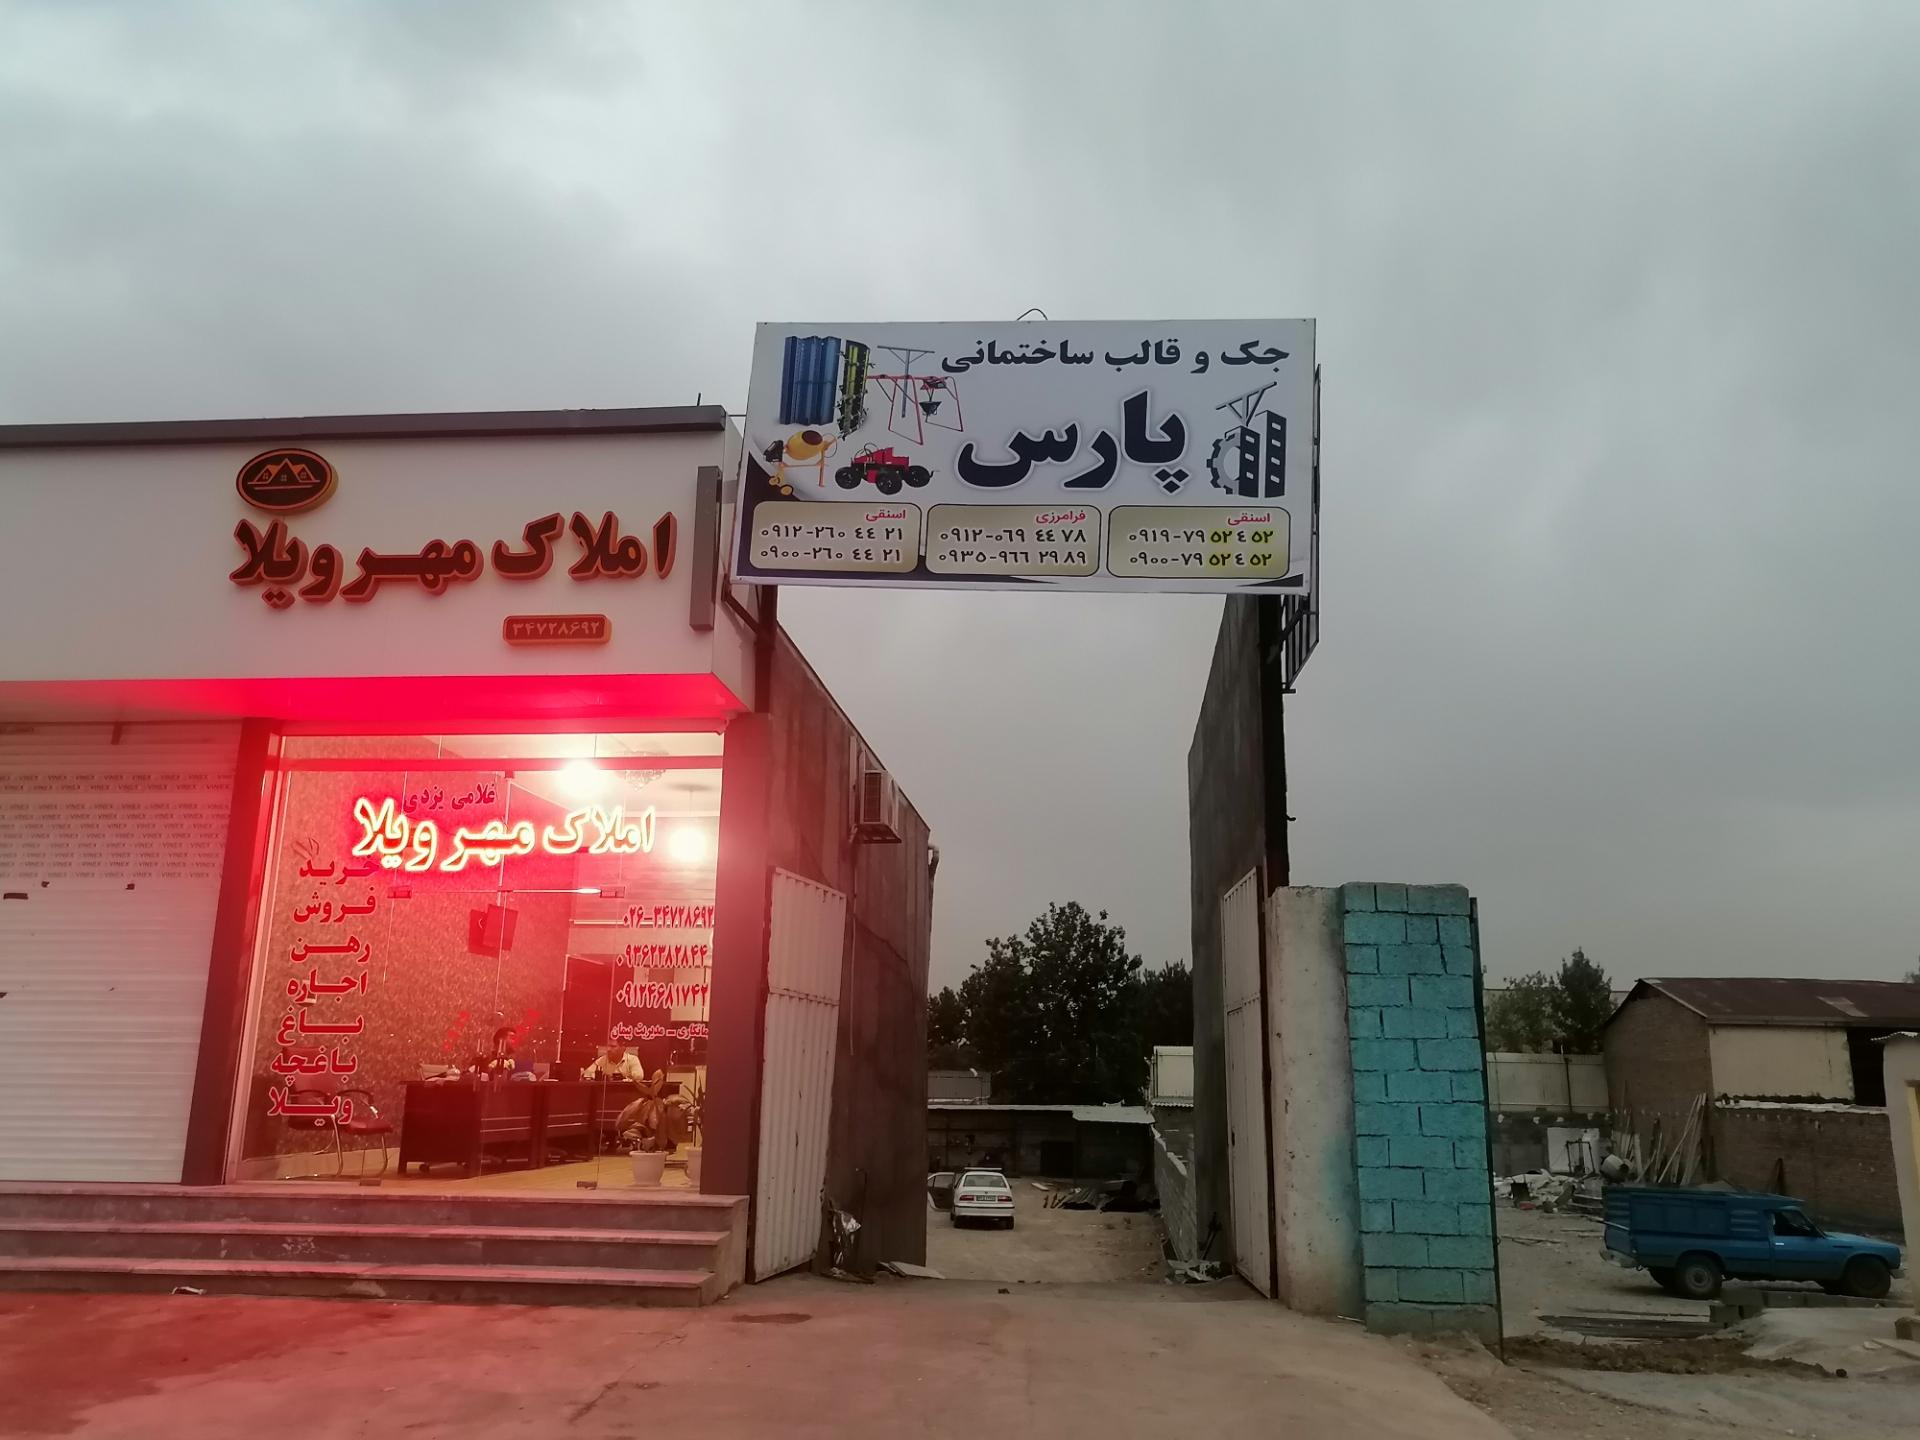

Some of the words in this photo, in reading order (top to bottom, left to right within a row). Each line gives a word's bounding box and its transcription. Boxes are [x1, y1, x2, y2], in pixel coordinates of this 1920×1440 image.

[941, 339, 1095, 373] ساختمانی
[1104, 338, 1182, 372] قالب
[1190, 351, 1210, 374] و
[1220, 340, 1290, 373] جک
[957, 389, 1191, 494] پارس
[865, 509, 906, 522] اسنقی
[1036, 510, 1086, 524] فرامرزی
[1227, 512, 1271, 526] اسنقی
[491, 511, 677, 582] املاک
[402, 785, 443, 813] یزدی
[451, 783, 497, 810] غلامی
[542, 805, 656, 855] املاک
[299, 854, 380, 886] خرید
[293, 886, 376, 923] فروش
[290, 935, 371, 963] رهن
[287, 968, 369, 1003] اجاره
[276, 1005, 364, 1045] باغ
[271, 1045, 358, 1087] باغچه
[267, 1086, 354, 1126] ویلا
